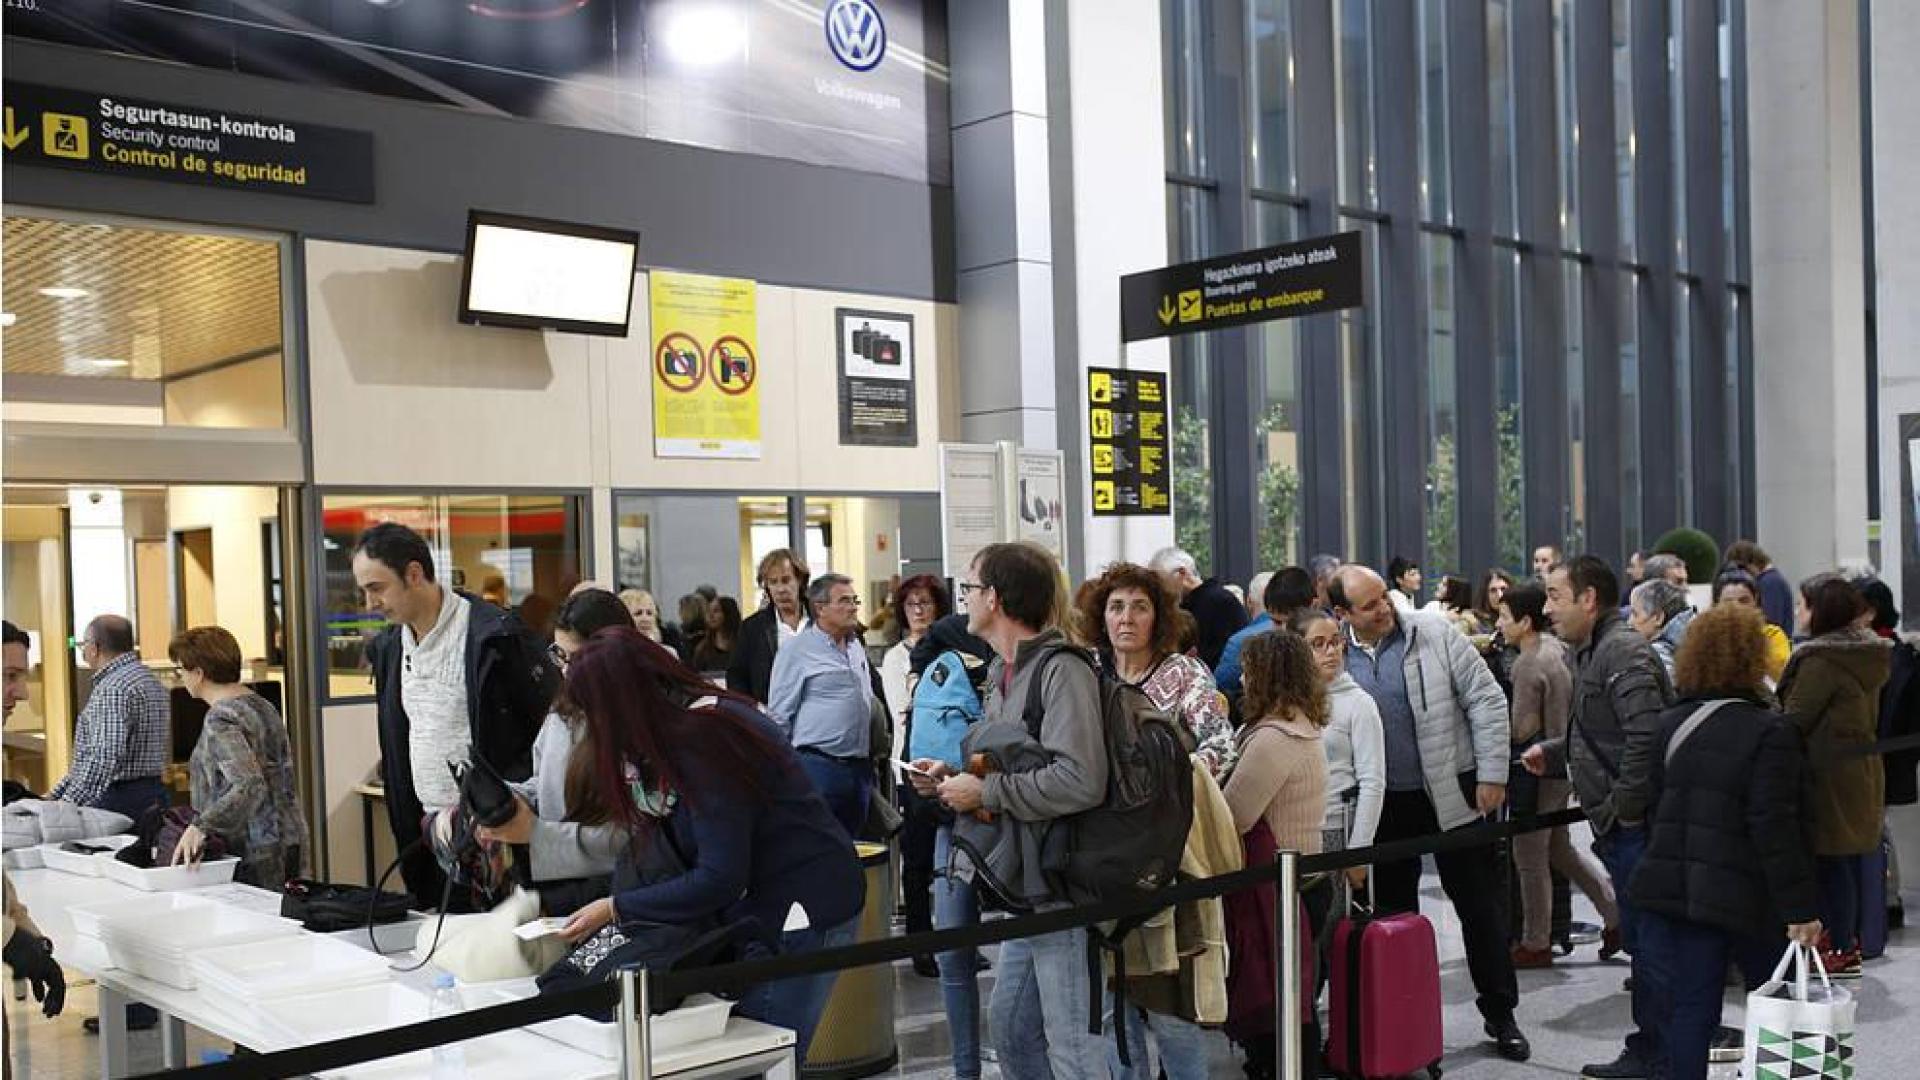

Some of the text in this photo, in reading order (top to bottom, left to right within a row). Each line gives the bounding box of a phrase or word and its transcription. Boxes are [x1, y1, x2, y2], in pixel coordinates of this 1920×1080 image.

[814, 77, 901, 109] Volkswagen
[100, 98, 296, 143] Segurtasun-kontrola
[101, 121, 220, 153] Security control
[102, 142, 306, 185] Control de seguridad
[1205, 289, 1323, 318] Puertas de embarque
